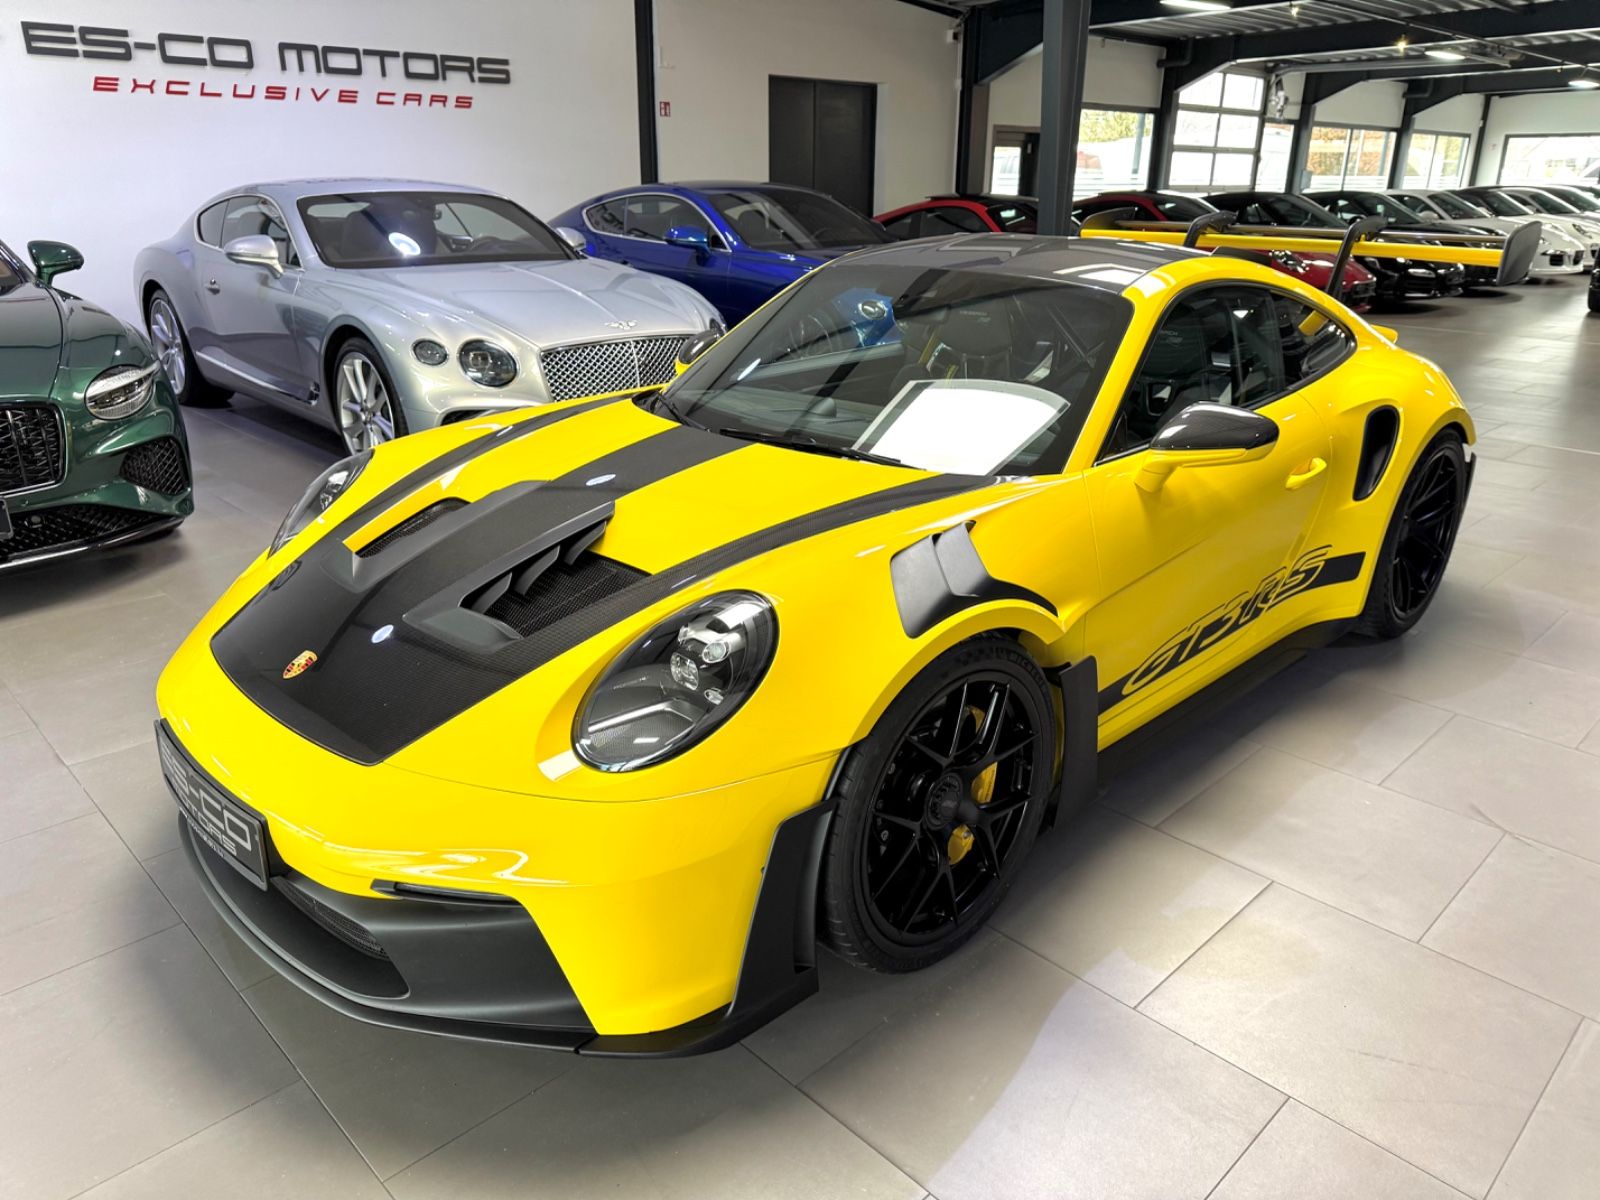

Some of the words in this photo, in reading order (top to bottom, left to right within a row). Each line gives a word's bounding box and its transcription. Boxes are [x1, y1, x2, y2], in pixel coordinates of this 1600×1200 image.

[20, 20, 254, 69] ES-CO
[278, 42, 511, 84] MOTORS
[93, 76, 359, 104] EXCLUSIVE
[376, 91, 473, 109] CARS
